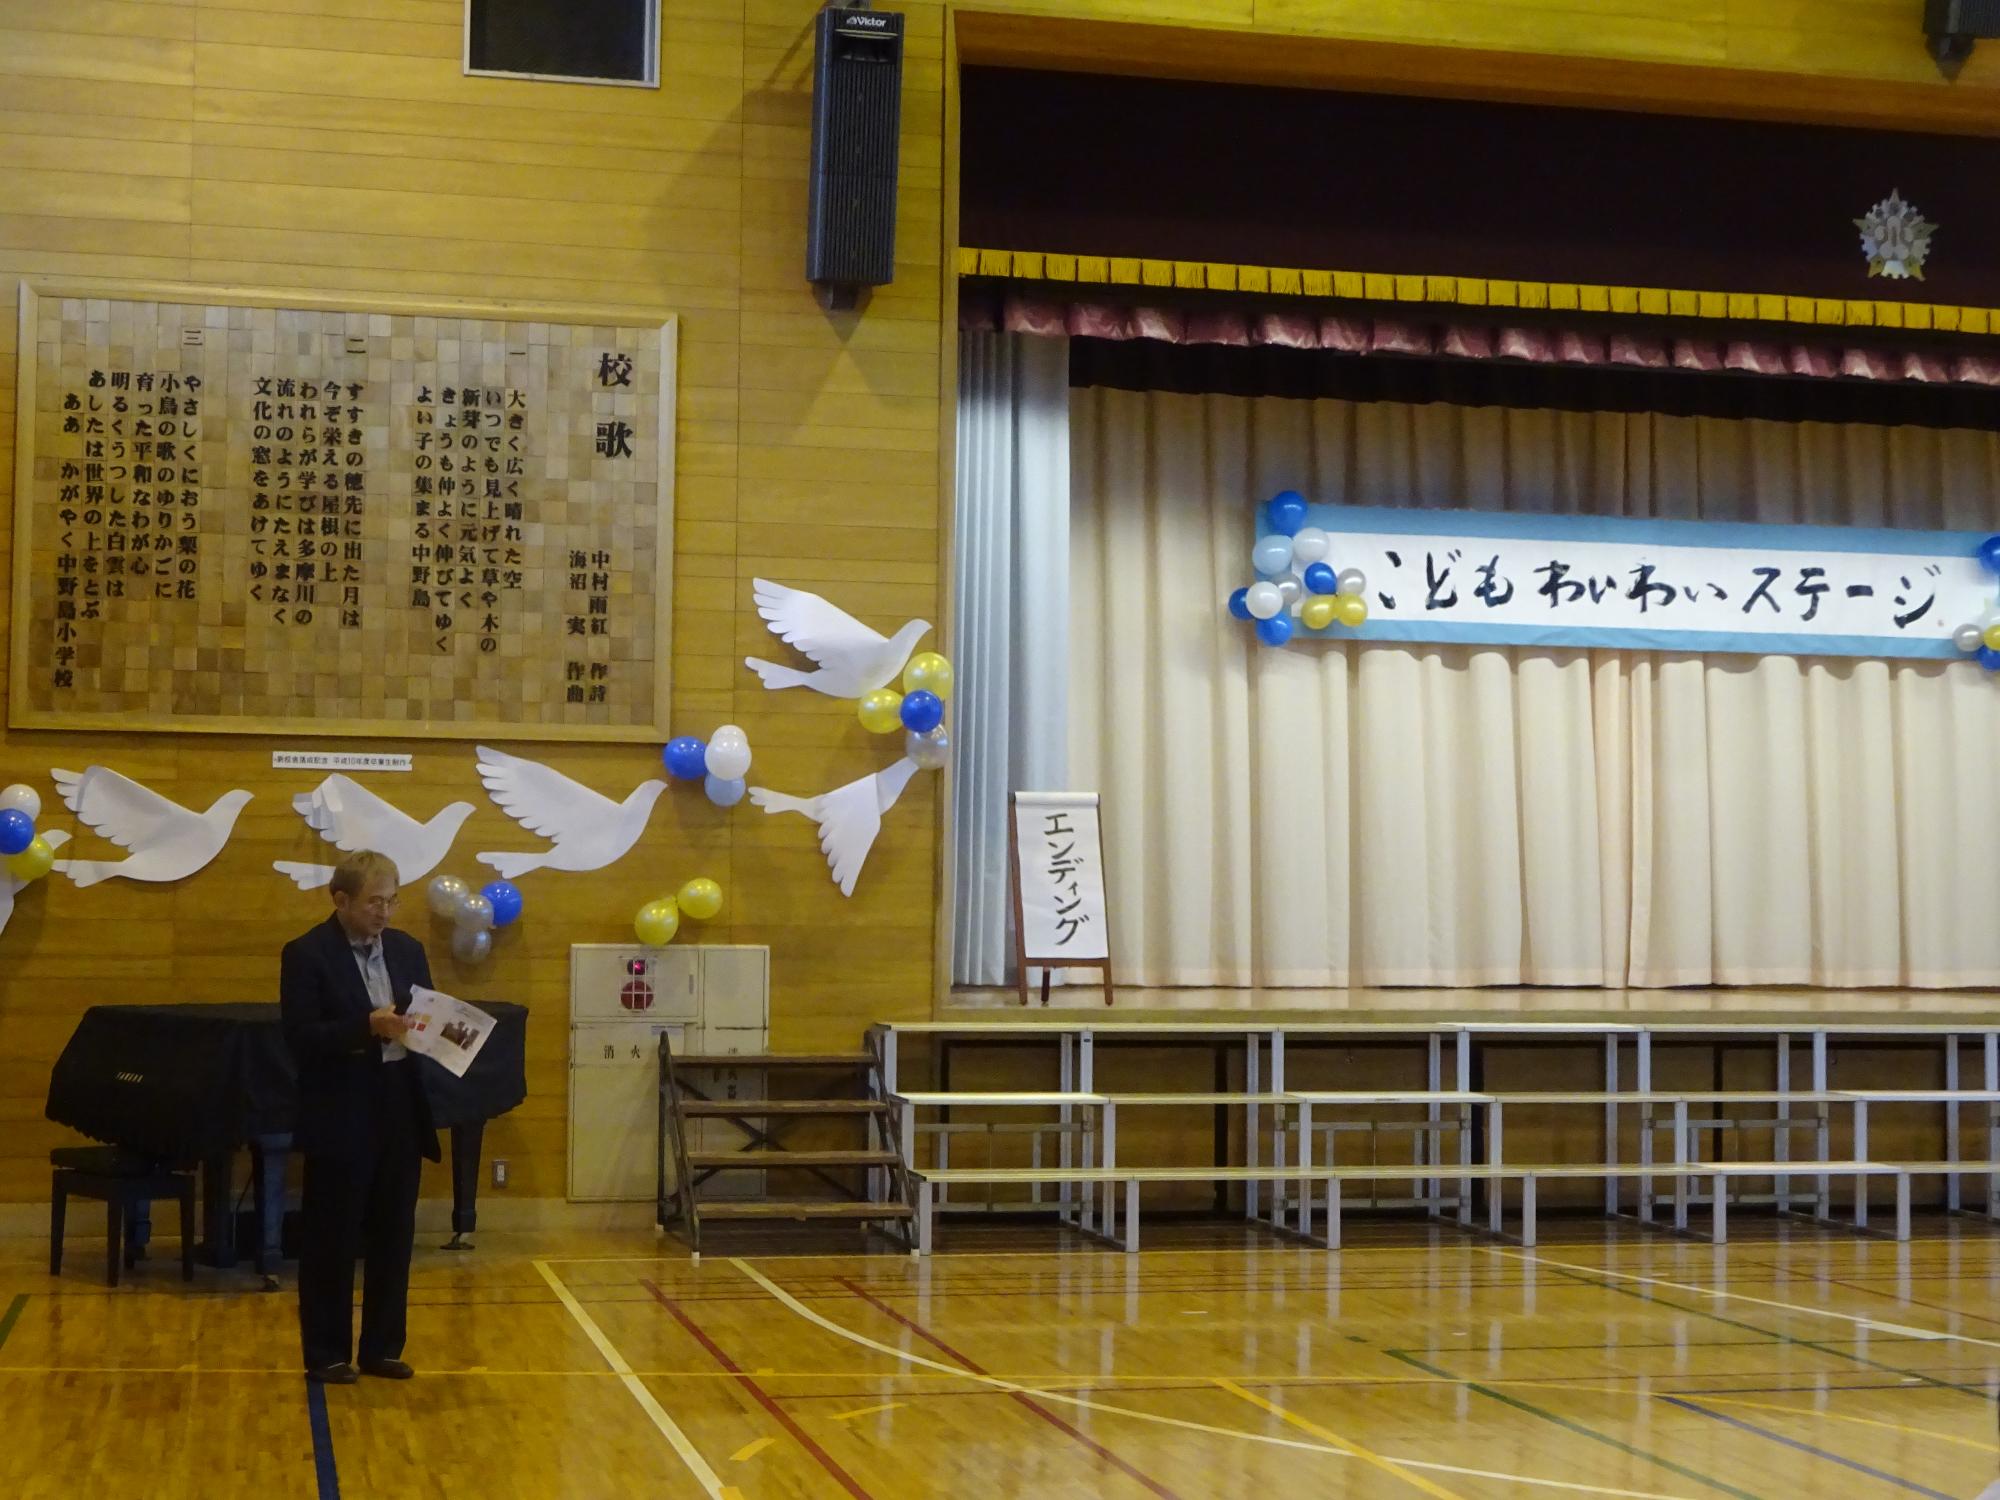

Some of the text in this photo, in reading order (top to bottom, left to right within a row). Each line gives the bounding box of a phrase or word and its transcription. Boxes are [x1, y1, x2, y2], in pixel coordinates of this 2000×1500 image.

[857, 16, 886, 26] Victor
[63, 394, 80, 433] ああ
[81, 370, 106, 619] あしたは世界の上をとぶ
[106, 371, 130, 598] 明るくうつした白雲は
[130, 373, 155, 575] 育った平和なわが心
[154, 373, 180, 598] 小鳥の歌のゆりかごに
[176, 376, 201, 599] やさしくにおう梨の花
[249, 377, 272, 601] 文化の窓をあけてゆく
[272, 378, 295, 625] 流れのようにたえまなく
[295, 381, 318, 626] われらが学びは多摩川の
[320, 381, 341, 582] 今ぞ栄える屋根の上
[343, 383, 364, 627] すすきの穂先に出た月は
[412, 386, 433, 608] よい子の集まる中野島
[459, 389, 481, 608] 新芽のように元気よく
[502, 389, 526, 590] 大きく広く晴れた空
[595, 352, 634, 459] 校歌
[435, 387, 457, 652] きょうも仲よく伸びてゆく
[480, 390, 502, 652] いつでも見上げて草や木の
[589, 550, 610, 635] 中村雨紅
[1043, 813, 1090, 946] エンディング
[604, 1045, 641, 1059] 消火
